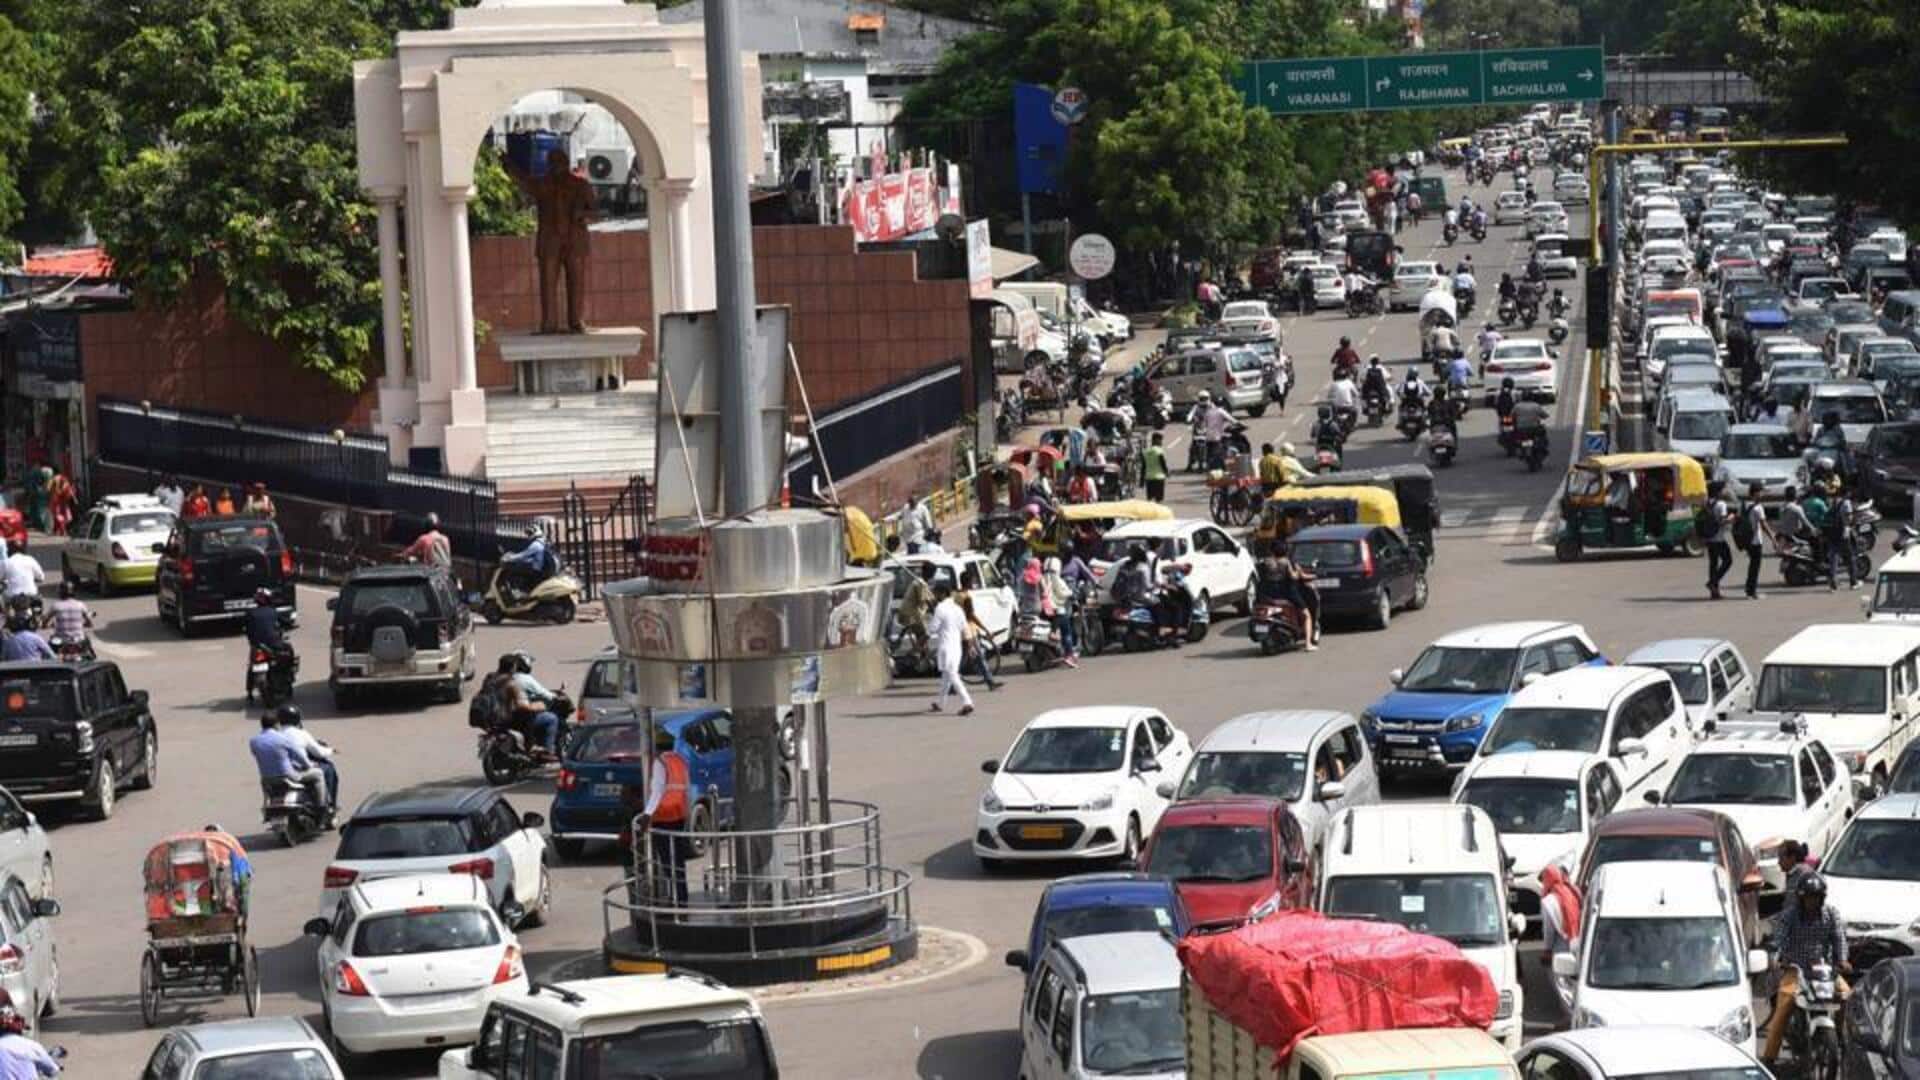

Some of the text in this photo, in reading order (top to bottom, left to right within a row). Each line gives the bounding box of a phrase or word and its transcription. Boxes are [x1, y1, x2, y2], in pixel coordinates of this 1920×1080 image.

[1400, 87, 1469, 101] RAJBHAWAN
[1492, 82, 1567, 97] SACHIVALAYA
[1288, 91, 1351, 105] VARANASI
